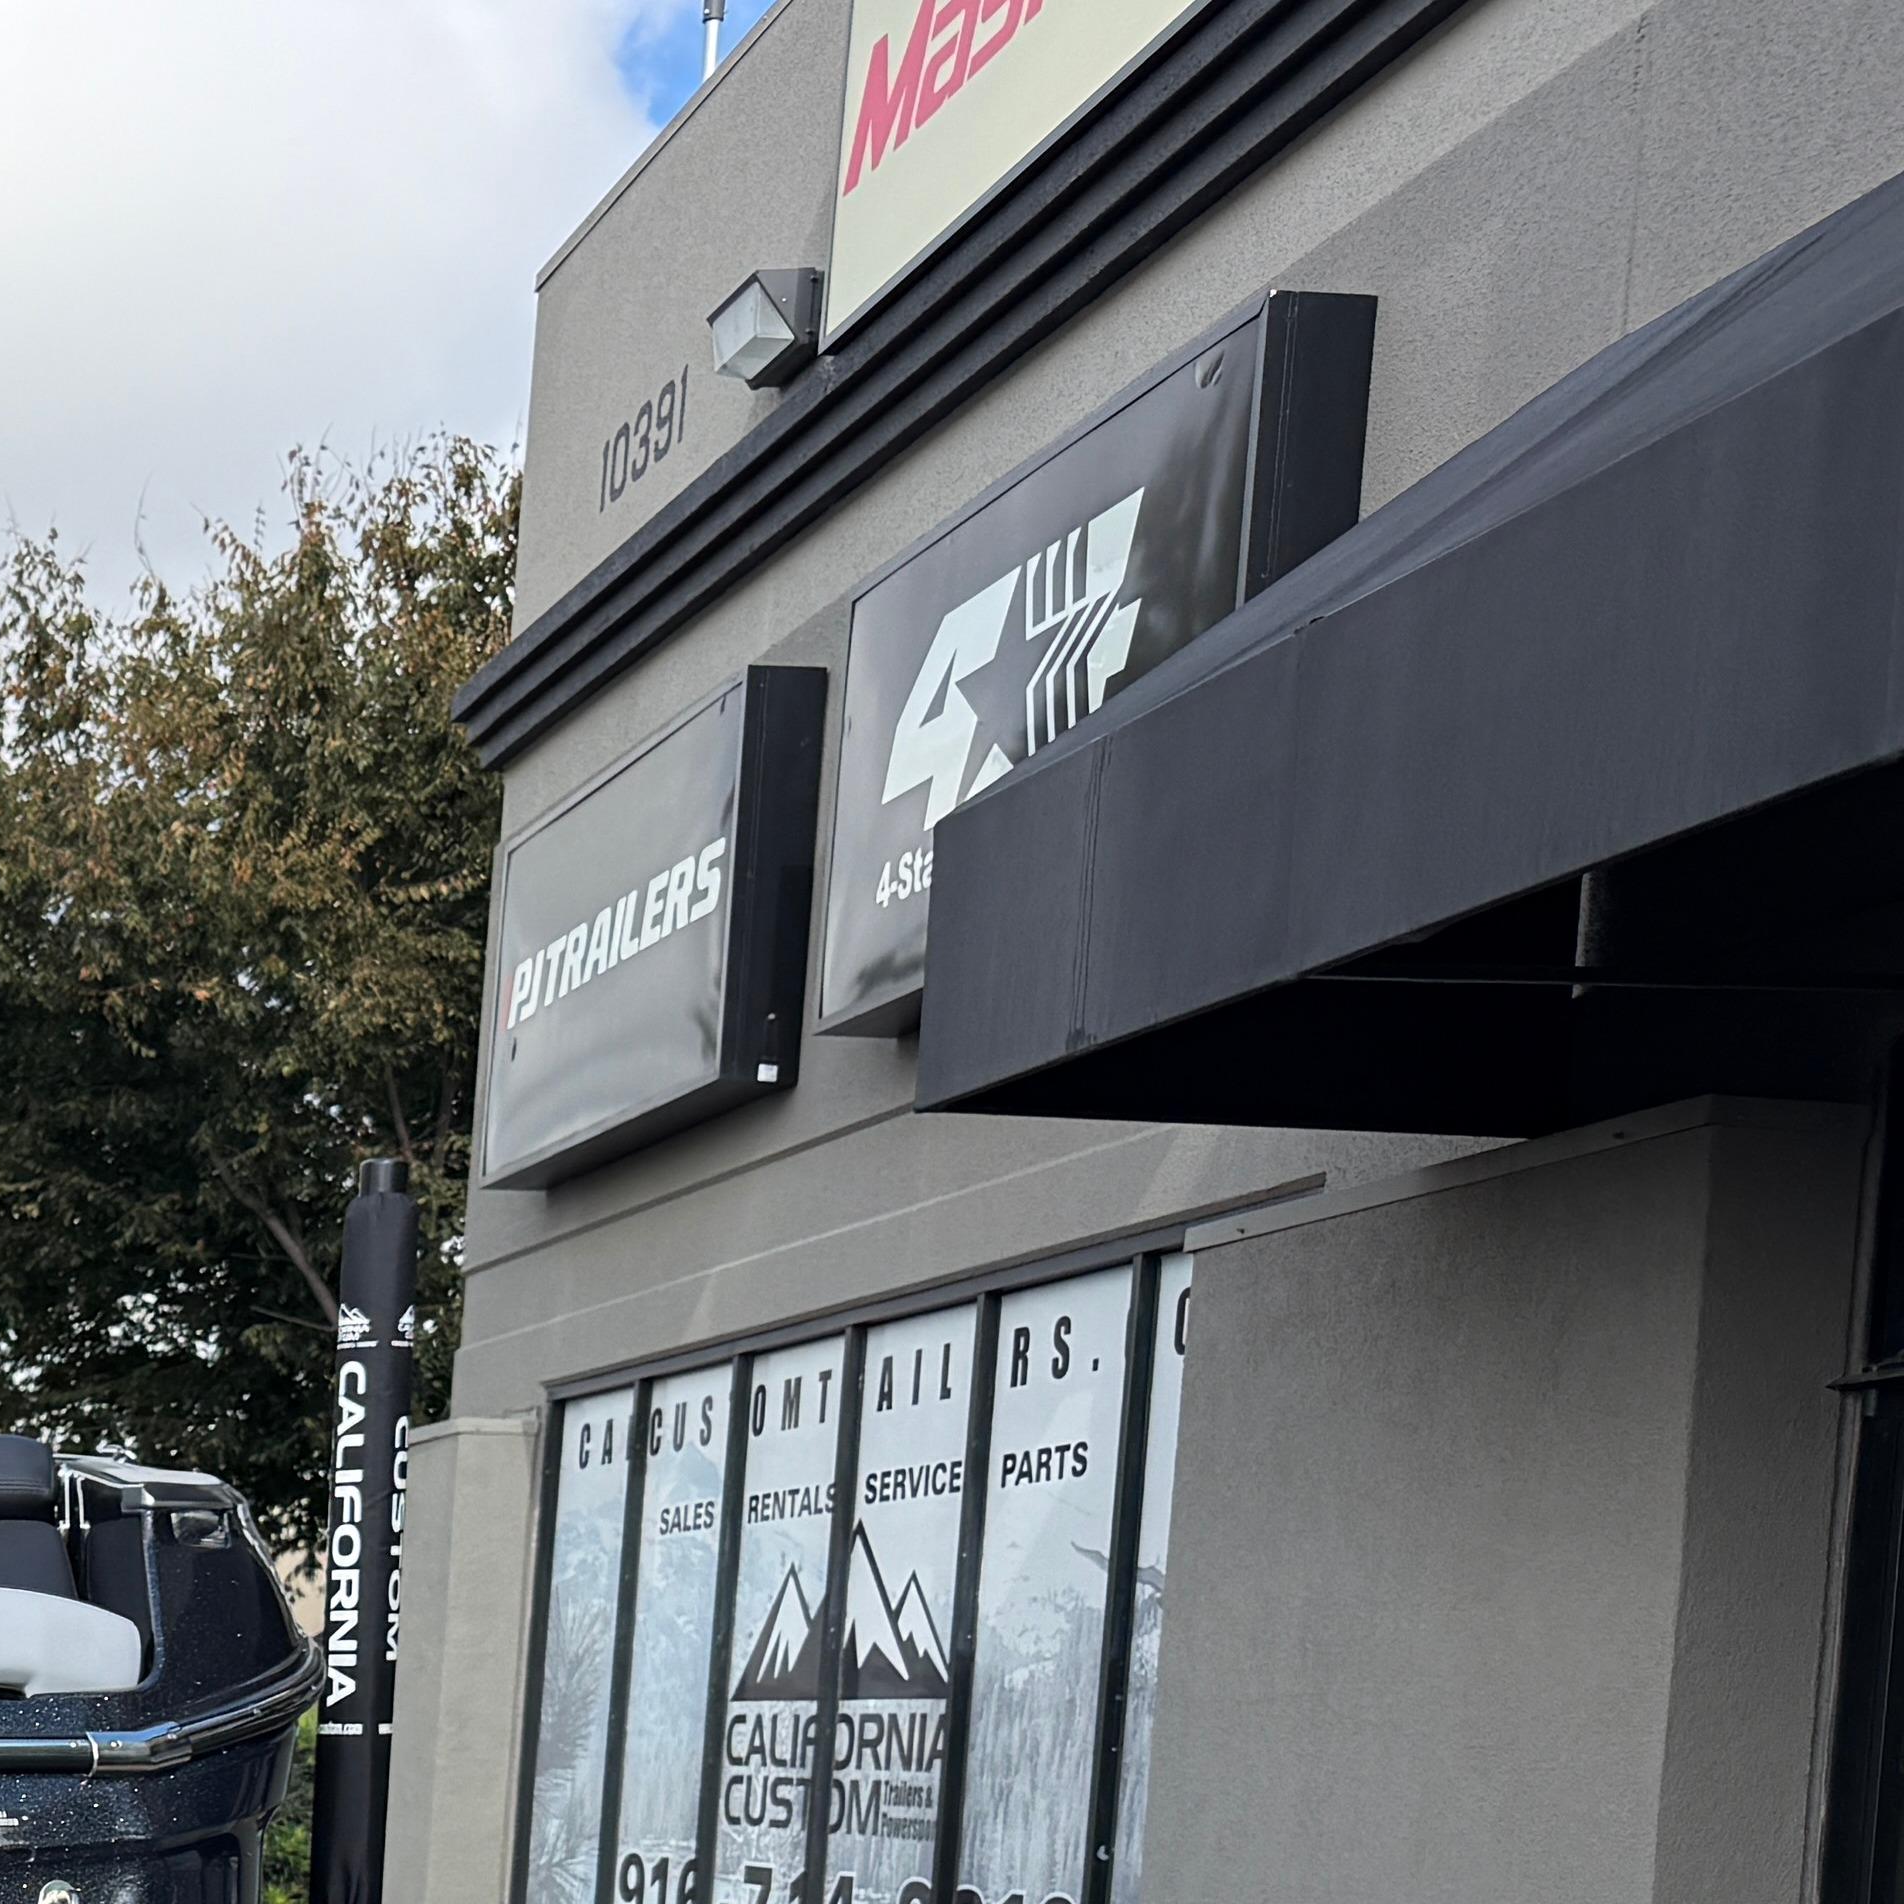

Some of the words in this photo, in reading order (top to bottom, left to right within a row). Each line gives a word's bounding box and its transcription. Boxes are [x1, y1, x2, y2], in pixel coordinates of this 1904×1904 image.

[599, 363, 689, 514] 10391
[325, 1360, 367, 1708] CALIFORNIA
[659, 1500, 715, 1536] SALES
[747, 1482, 838, 1524] RENTALS
[864, 1460, 963, 1505] SERVICE
[1001, 1441, 1089, 1489] PARTS
